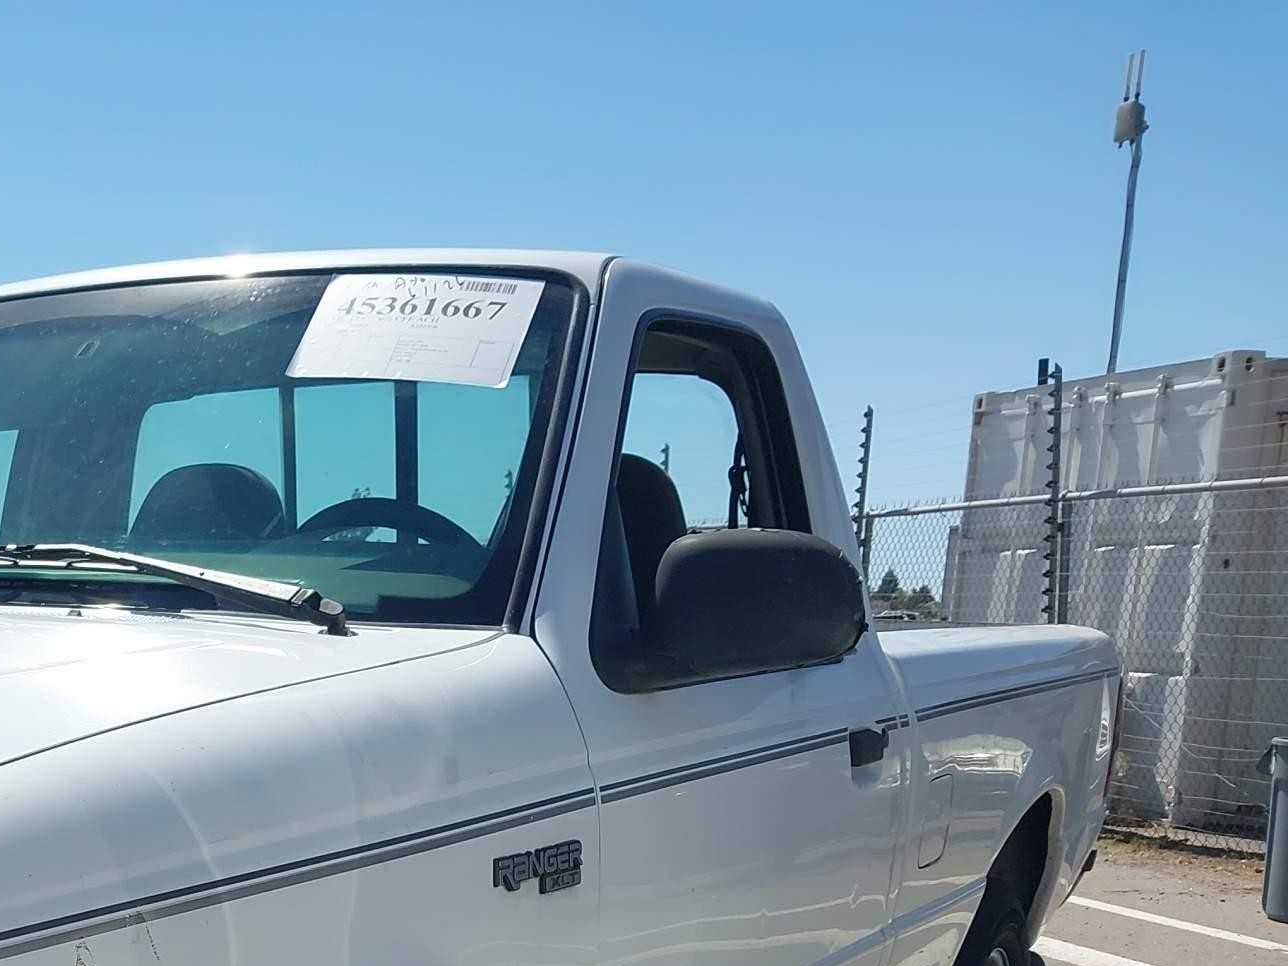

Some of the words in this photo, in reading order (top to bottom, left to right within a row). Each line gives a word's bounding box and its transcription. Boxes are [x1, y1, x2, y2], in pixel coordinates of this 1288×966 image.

[336, 295, 510, 321] 45361667
[493, 839, 583, 891] RANGER
[545, 871, 580, 892] XLT
